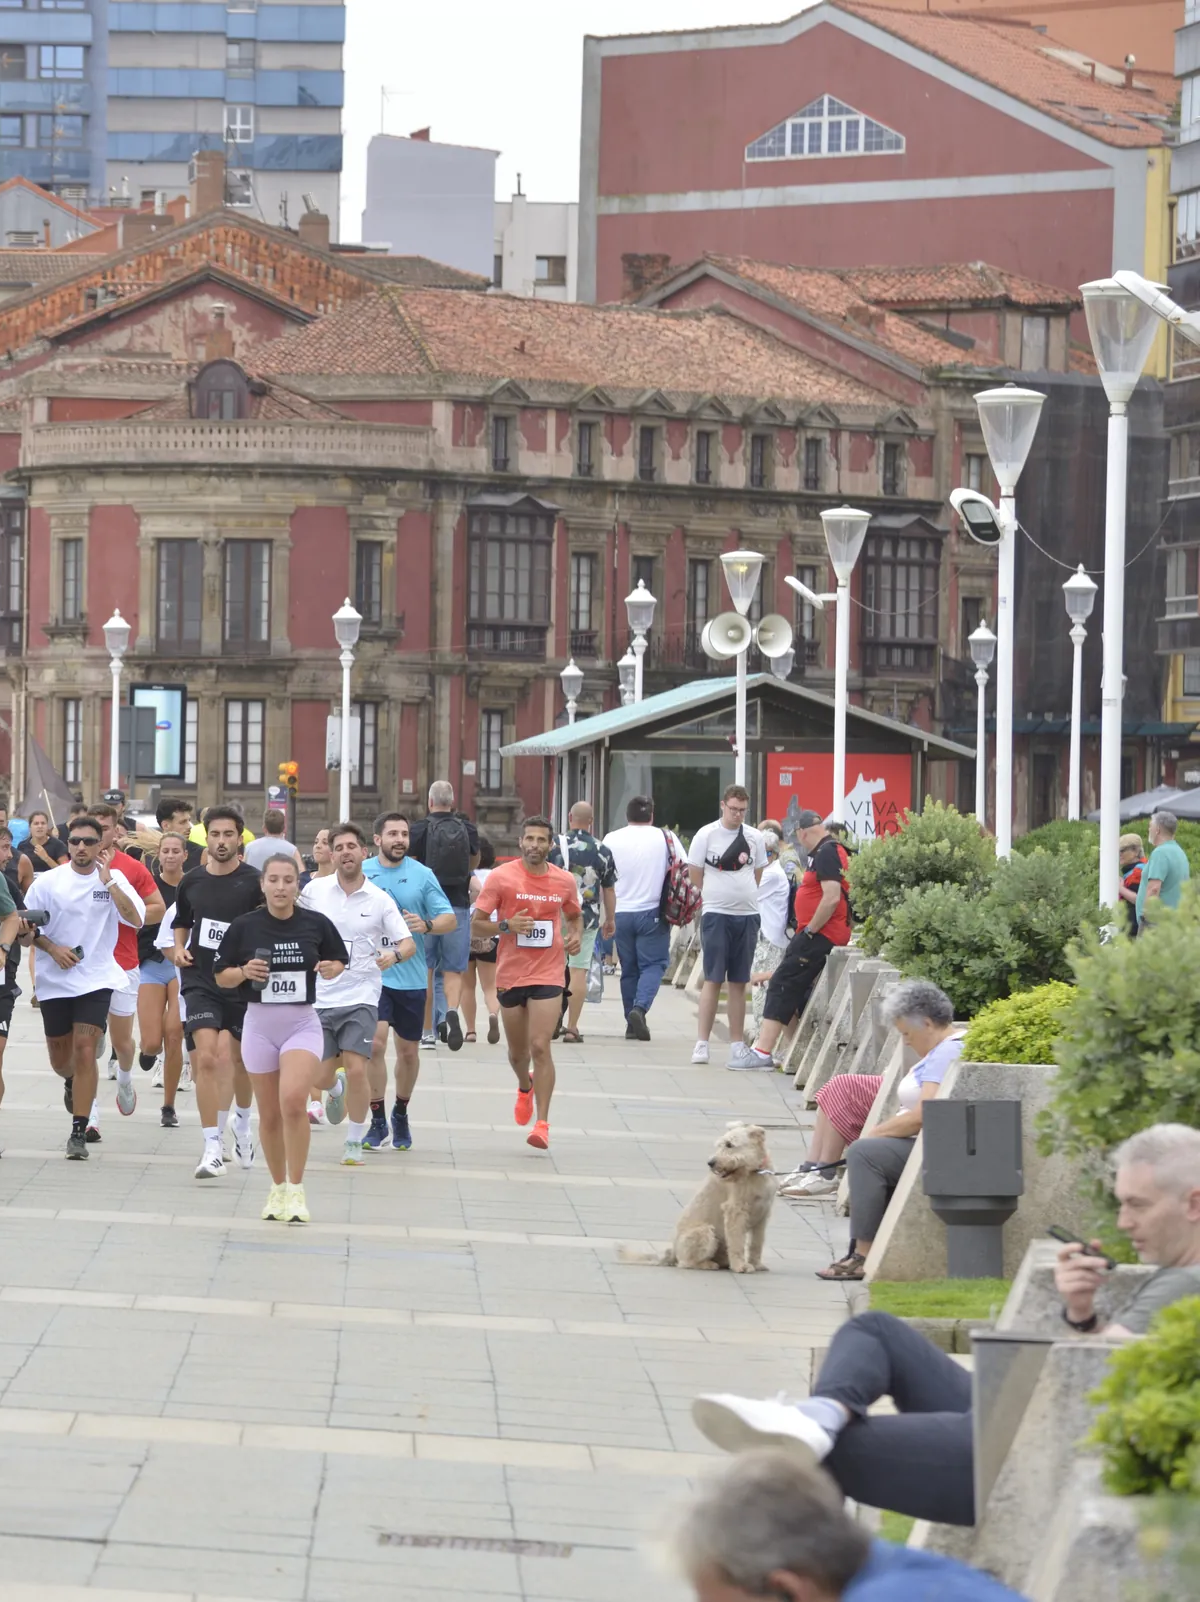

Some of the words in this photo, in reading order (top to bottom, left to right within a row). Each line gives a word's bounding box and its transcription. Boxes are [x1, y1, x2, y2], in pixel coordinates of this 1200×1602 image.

[850, 801, 899, 816] VIVA
[516, 893, 547, 901] KIPPING
[208, 928, 223, 941] 06
[274, 942, 300, 950] VUELTA
[272, 955, 304, 965] ORÍGENES
[272, 980, 296, 993] 044
